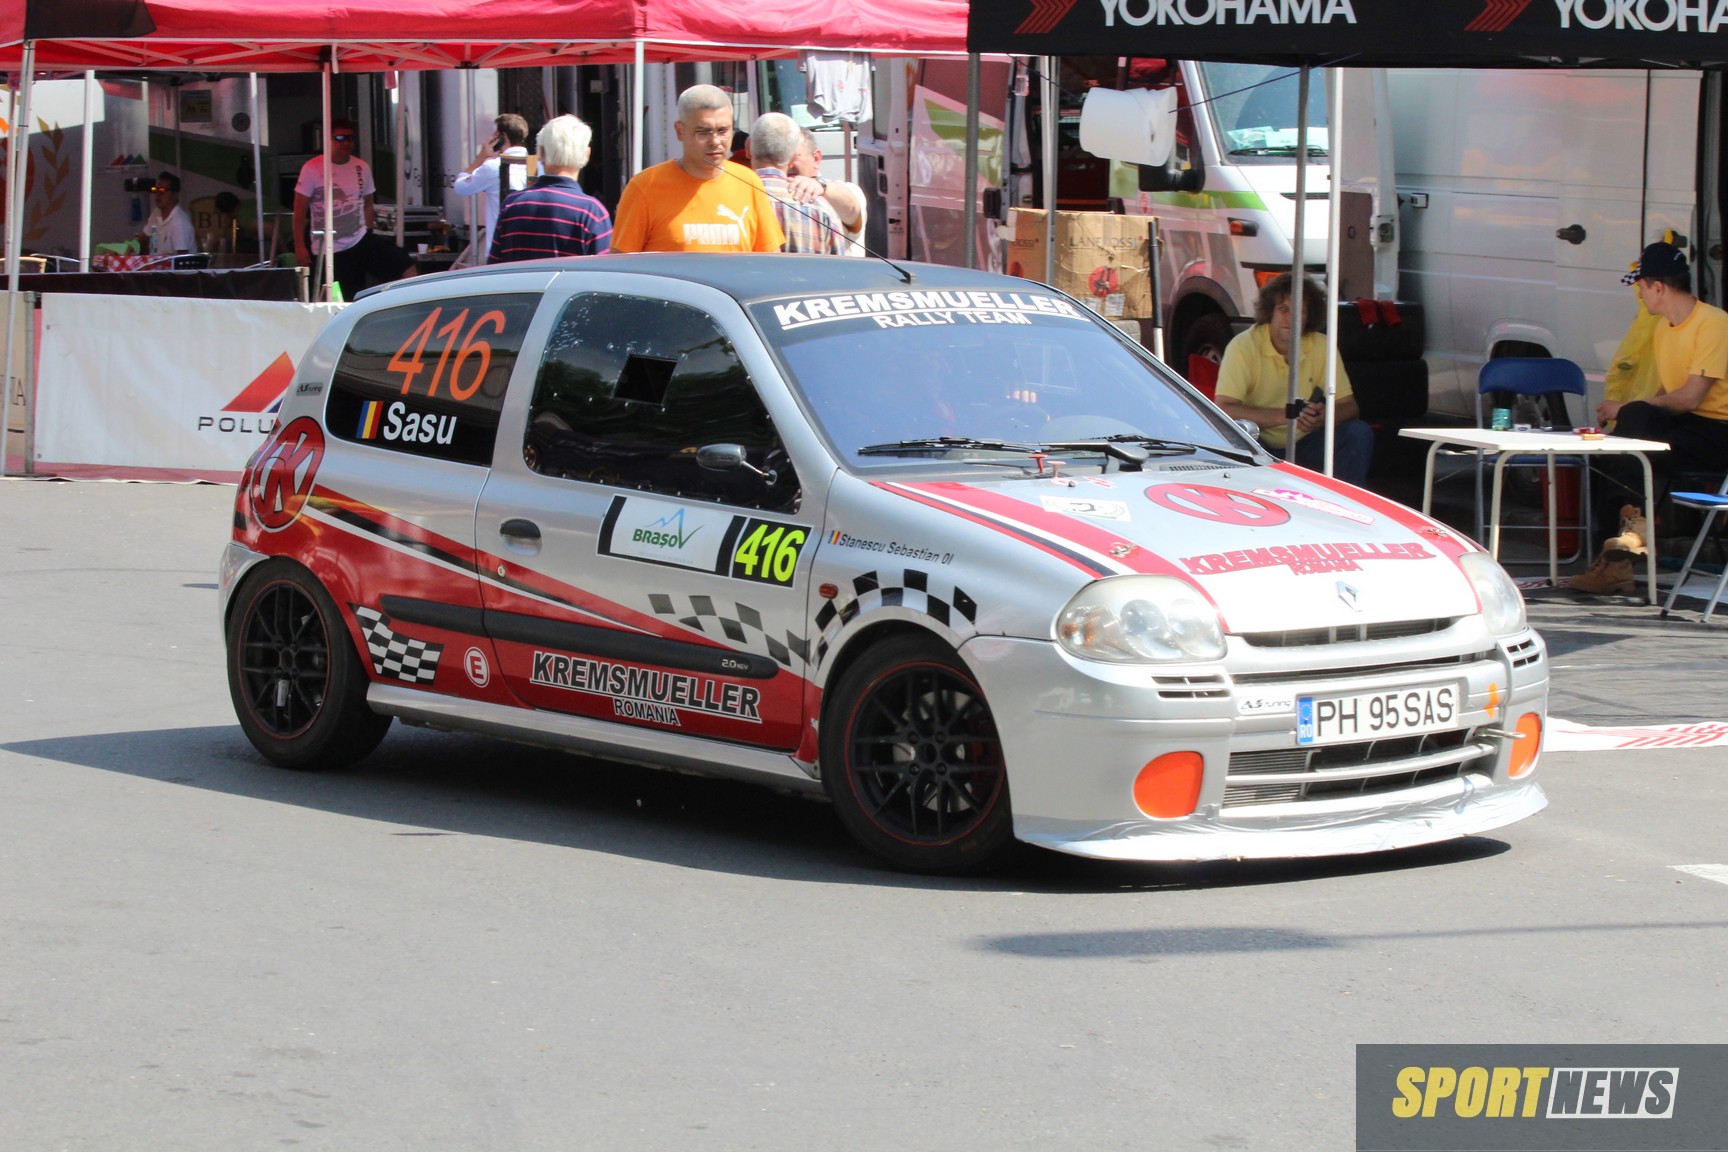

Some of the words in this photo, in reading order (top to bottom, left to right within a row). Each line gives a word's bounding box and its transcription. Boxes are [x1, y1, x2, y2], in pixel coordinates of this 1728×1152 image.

[1101, 0, 1357, 26] YOKOHAMA
[683, 223, 740, 245] PUMA
[773, 291, 1082, 326] KREMSMUELLER
[873, 311, 955, 328] RALLY
[959, 310, 1032, 325] TEAM
[387, 306, 506, 401] 416
[383, 401, 457, 445] Sasu
[735, 524, 805, 582] 416
[839, 533, 886, 552] Stanescu
[887, 541, 940, 563] Sebastian
[1179, 542, 1437, 575] KREMSMUELLER
[533, 650, 761, 719] KREMSMUELLER
[613, 698, 681, 727] ROMANIA
[1317, 698, 1358, 737] PH
[1300, 724, 1313, 739] RO
